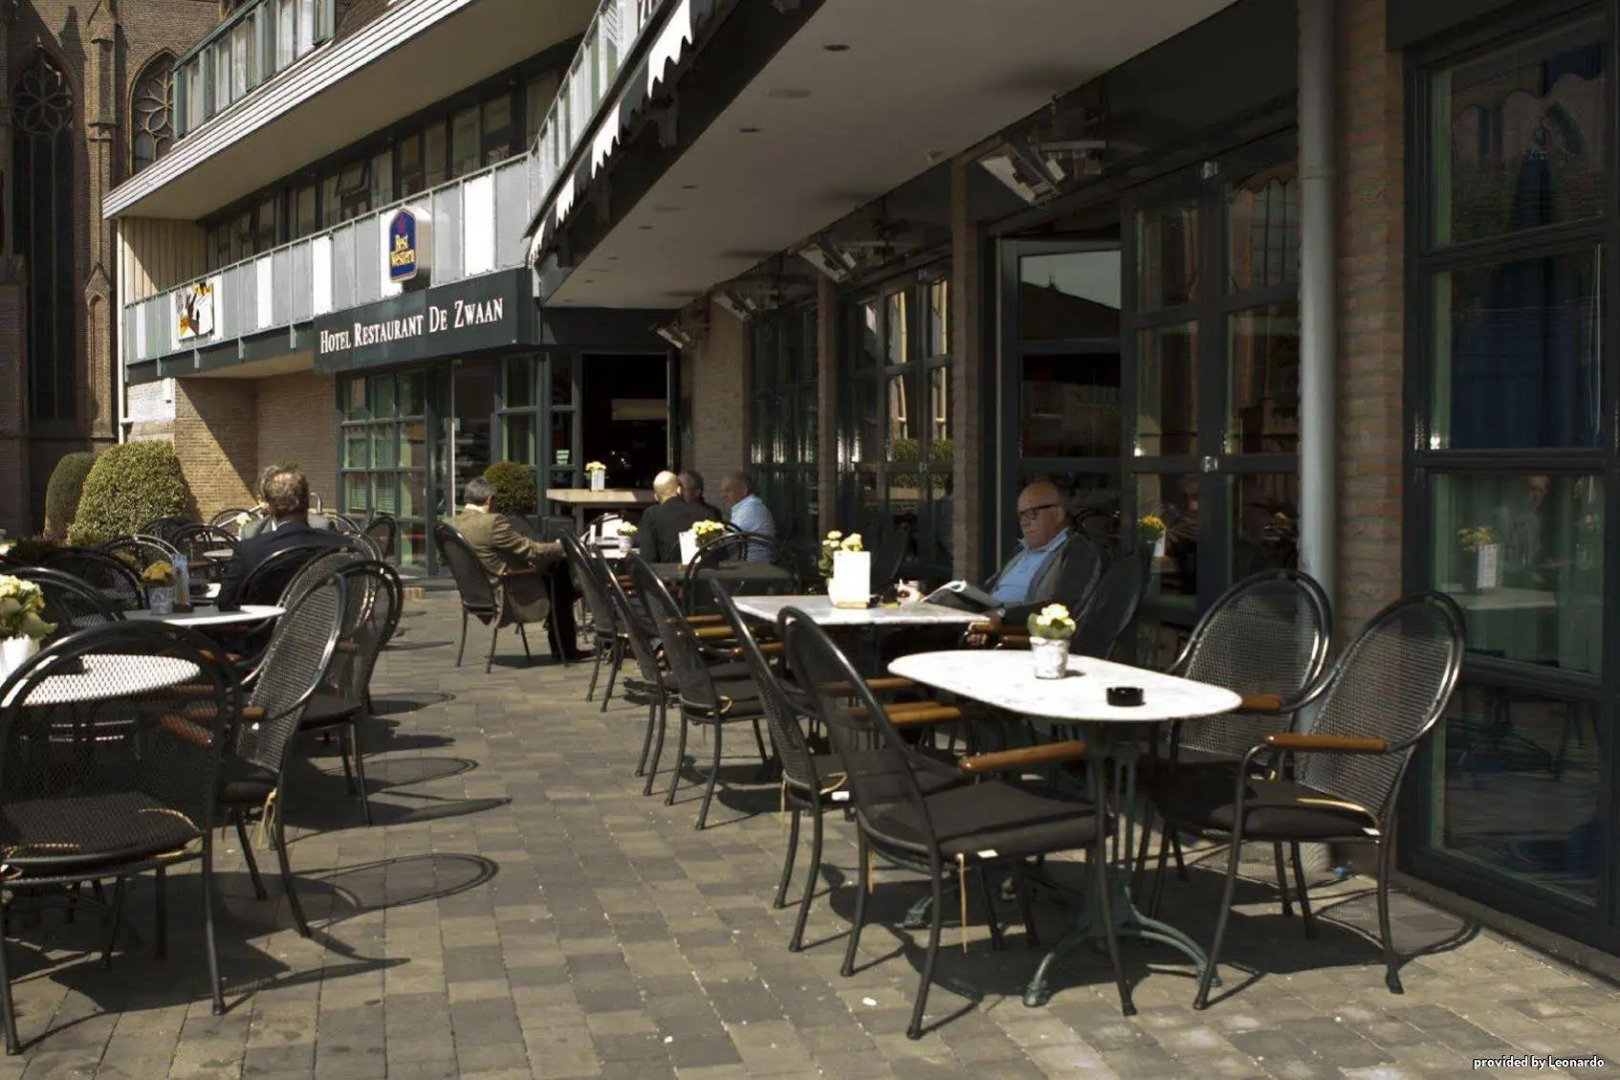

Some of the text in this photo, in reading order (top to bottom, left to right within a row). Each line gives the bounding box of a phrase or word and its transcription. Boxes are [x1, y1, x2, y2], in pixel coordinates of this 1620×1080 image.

[320, 298, 503, 354] HOTEL RESTAURANT DE ZWAAN
